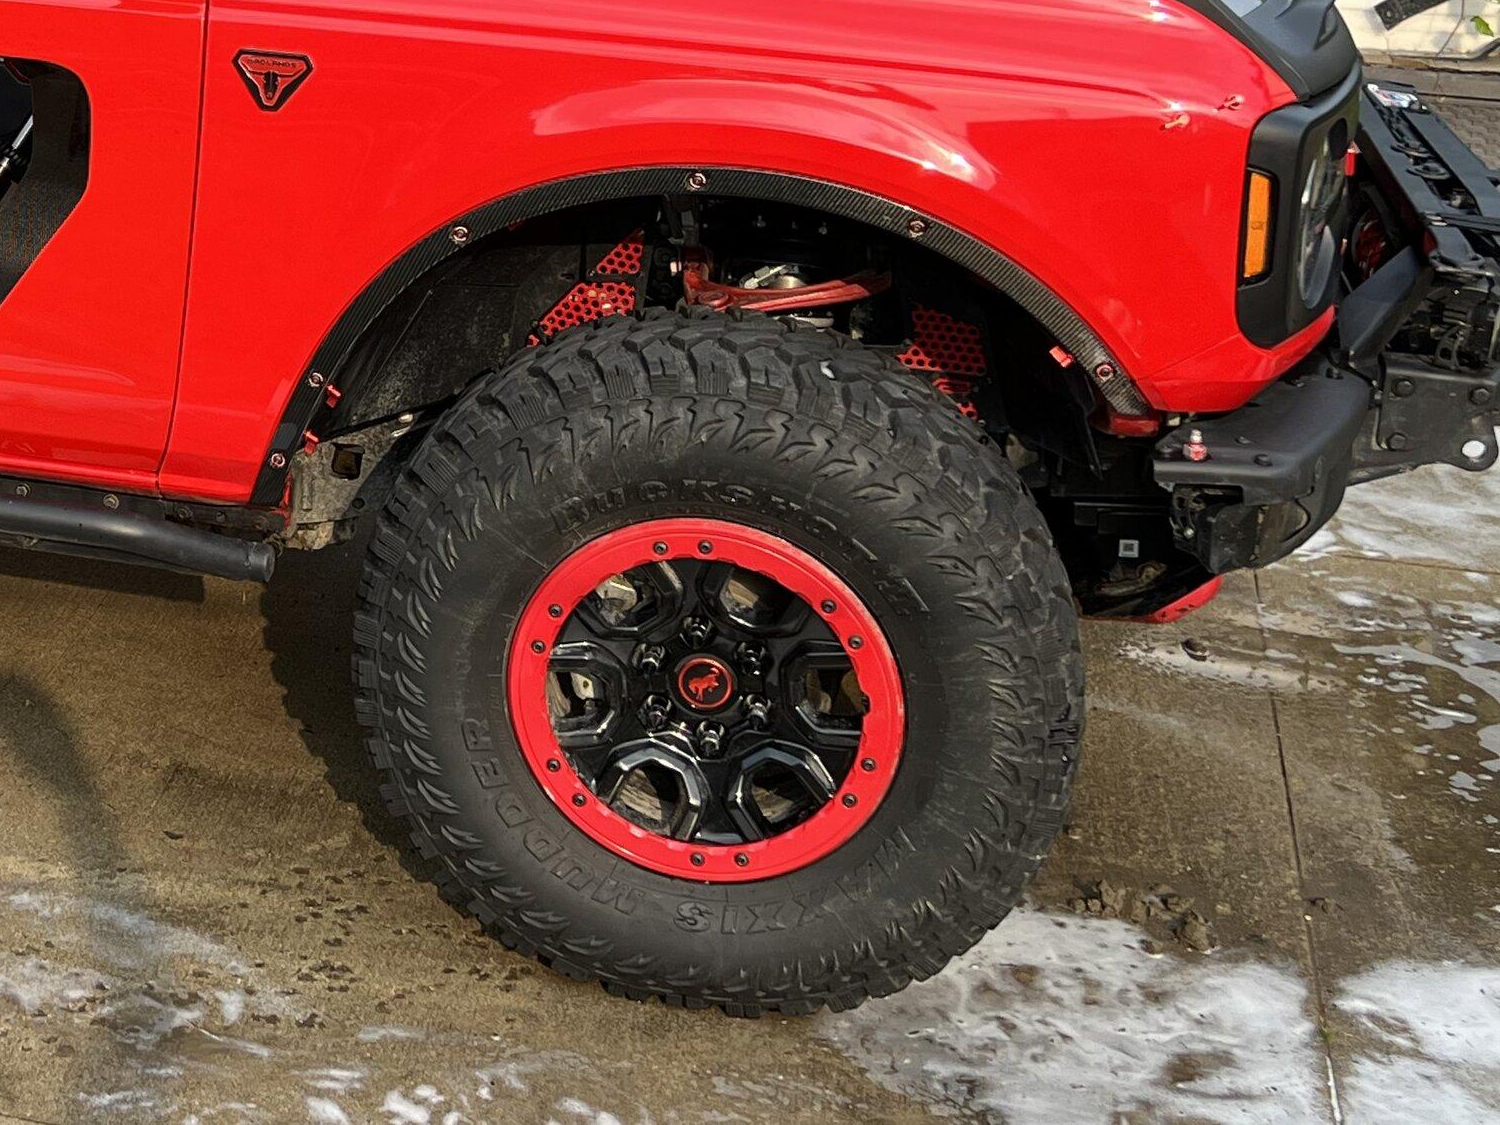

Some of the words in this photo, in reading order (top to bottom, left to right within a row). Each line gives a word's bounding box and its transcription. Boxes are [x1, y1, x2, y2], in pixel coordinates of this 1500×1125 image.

[247, 58, 297, 69] BADLANDS
[551, 478, 878, 562] BUCKSHOT
[461, 718, 646, 915] MUDDER
[672, 826, 917, 936] MAXXIS
